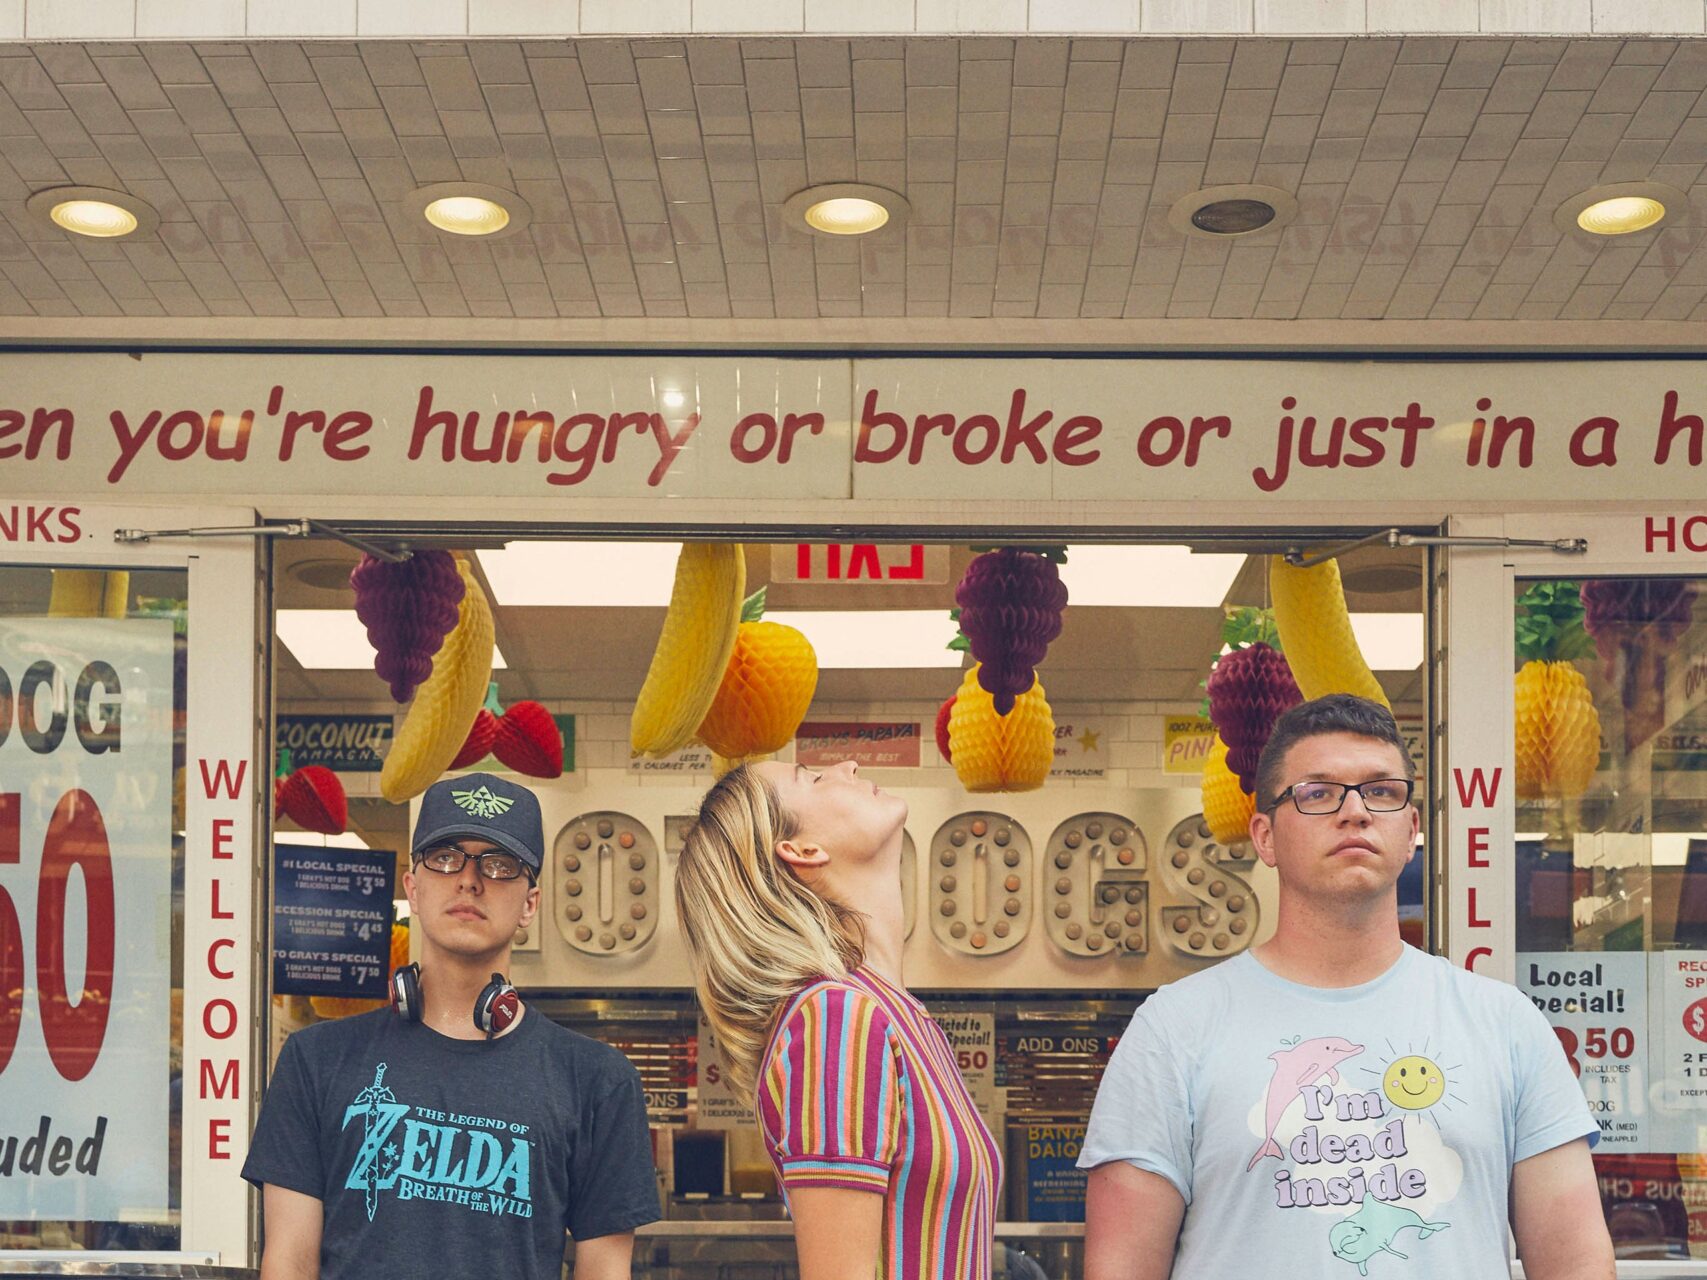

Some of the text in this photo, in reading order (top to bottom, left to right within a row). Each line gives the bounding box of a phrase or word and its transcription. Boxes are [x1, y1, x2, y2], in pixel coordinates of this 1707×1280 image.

[107, 386, 372, 484] you're
[408, 386, 702, 487] hungry
[731, 408, 824, 464] or
[854, 388, 1102, 466] broke
[1136, 415, 1232, 468] or
[1252, 395, 1435, 493] just
[1466, 397, 1535, 468] in
[1569, 417, 1620, 467] a
[0, 660, 121, 755] OG
[276, 722, 394, 749] COCONUT
[857, 723, 913, 741] PAPAYA
[277, 749, 382, 760] AMPAGNE
[296, 860, 334, 871] LOCAL
[336, 863, 385, 874] SPECIAL
[899, 810, 1262, 958] OGS
[335, 908, 384, 920] SPECIAL
[198, 758, 249, 1160] WELCOME
[289, 950, 330, 961] GRAY'S
[332, 953, 380, 964] SPECIAL
[1530, 963, 1602, 987] Local
[1685, 977, 1707, 988] SP
[1522, 988, 1625, 1013] pecial!
[970, 1019, 981, 1032] to
[1017, 1038, 1099, 1052] ADD ONS
[1683, 1053, 1692, 1062] 2
[1585, 1065, 1631, 1073] INCLUDES
[1684, 1067, 1690, 1076] 1
[1600, 1076, 1617, 1084] TAX
[1298, 1084, 1384, 1121] I'm
[416, 1106, 530, 1135] THE LEGEND OF
[1616, 1124, 1638, 1132] (MED)
[1030, 1142, 1084, 1158] DAIQ
[1289, 1119, 1408, 1164] dead
[341, 1103, 531, 1201] ZELDA
[1274, 1162, 1427, 1209] inside
[397, 1177, 533, 1218] BREATH OF THE WILD
